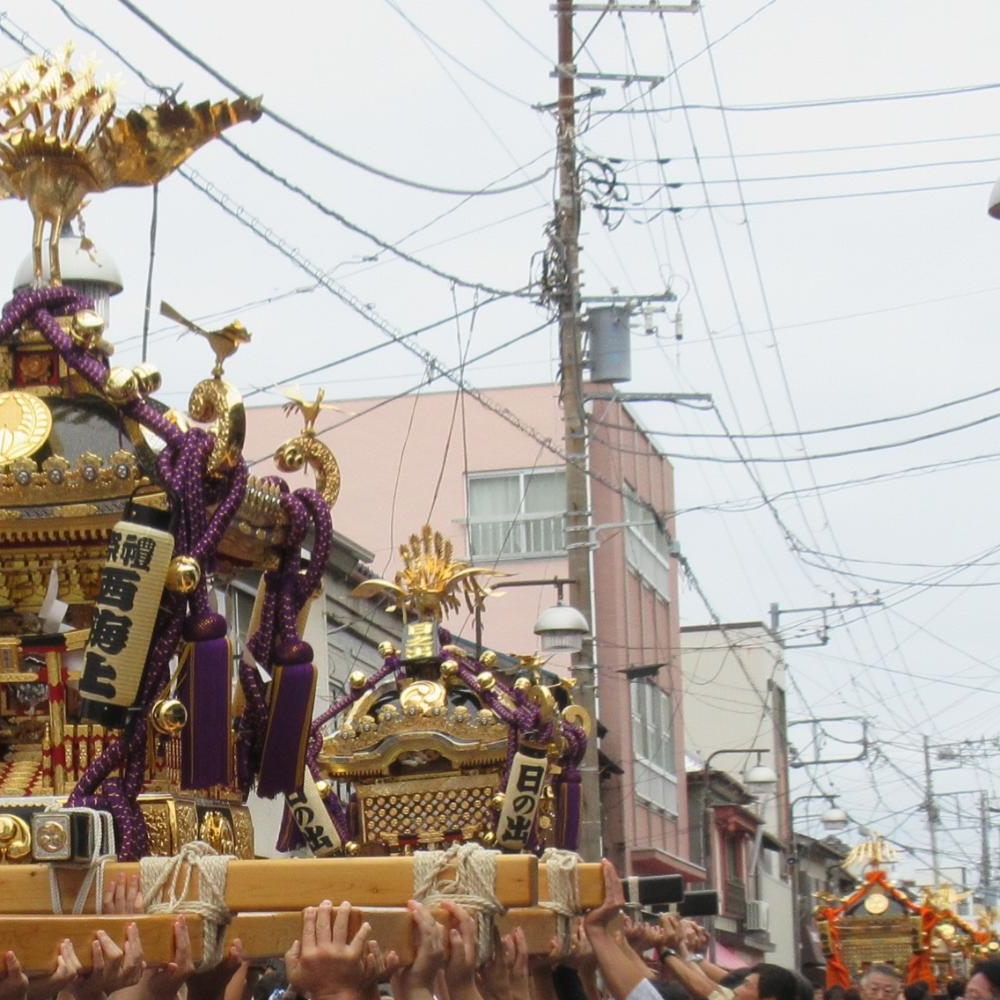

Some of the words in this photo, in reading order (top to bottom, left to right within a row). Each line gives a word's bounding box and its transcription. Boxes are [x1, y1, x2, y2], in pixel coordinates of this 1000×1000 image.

[79, 567, 140, 699] 西海上
[504, 765, 543, 845] 日の出
